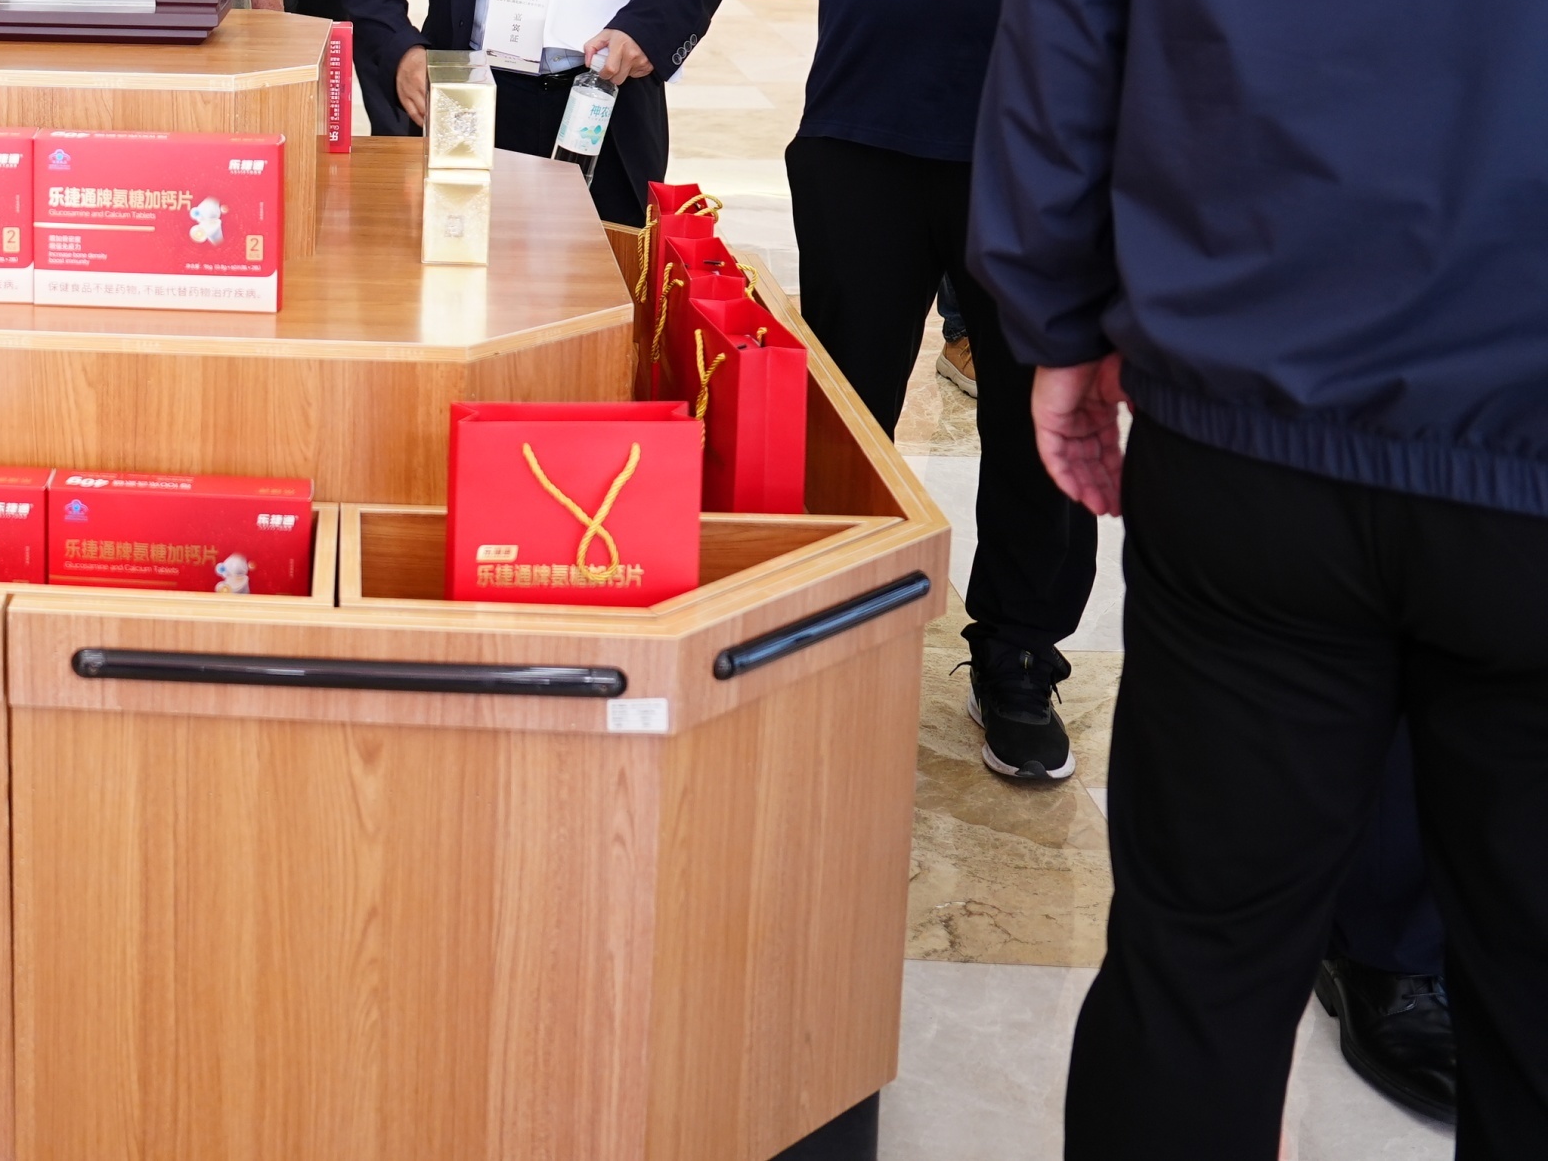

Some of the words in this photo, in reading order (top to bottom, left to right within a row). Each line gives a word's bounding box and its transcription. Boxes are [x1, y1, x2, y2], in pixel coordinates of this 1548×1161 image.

[48, 187, 193, 211] 乐捷通牌氨糖加钙片
[49, 209, 90, 218] Glucosamine
[91, 210, 103, 218] and
[104, 210, 131, 219] Calcium
[132, 211, 156, 220] Tablets
[7, 230, 16, 244] 2
[250, 238, 259, 252] 2
[256, 513, 296, 526] 乐捷通
[65, 539, 218, 566] 乐捷通牌氨糖加钙片
[65, 561, 109, 571] Glucosamine
[109, 564, 123, 572] and
[124, 564, 152, 574] Calcium
[153, 565, 179, 575] Tablets
